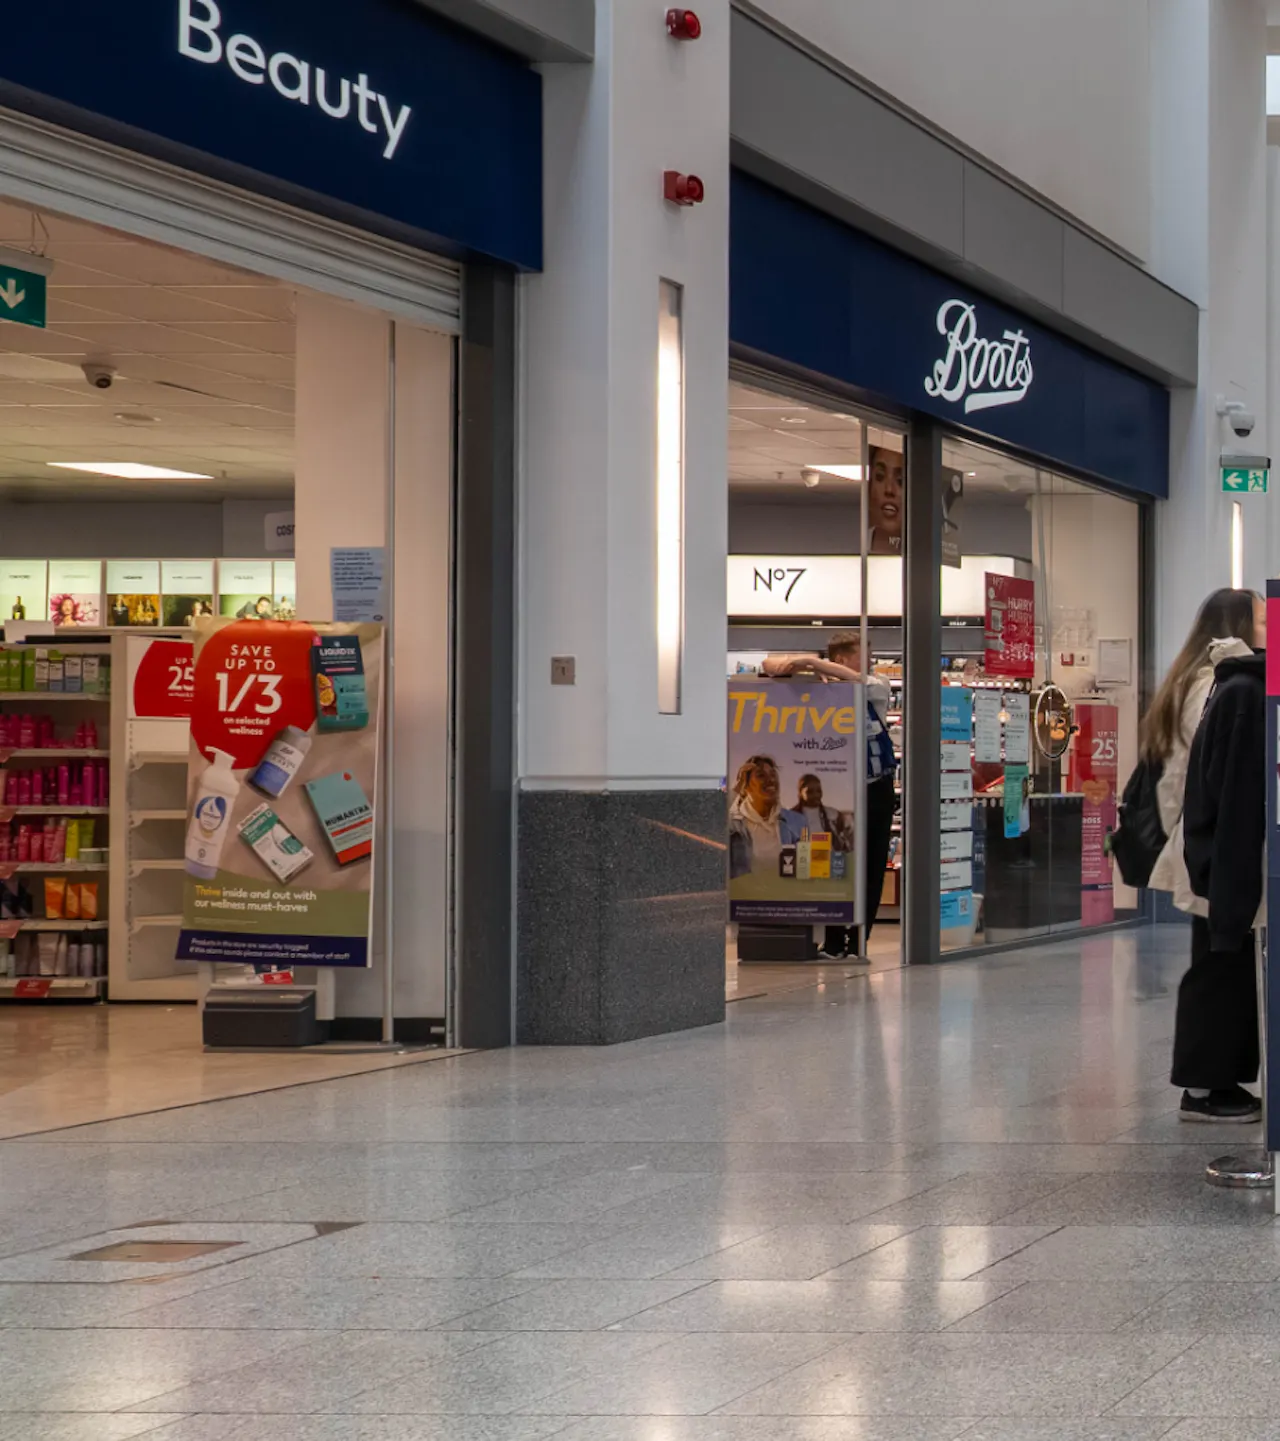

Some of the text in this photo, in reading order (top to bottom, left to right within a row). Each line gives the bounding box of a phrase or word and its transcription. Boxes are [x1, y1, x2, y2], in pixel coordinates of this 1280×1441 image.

[177, 0, 411, 159] Beauty
[925, 299, 1034, 413] Boots
[230, 644, 273, 656] SAVE
[225, 659, 276, 671] UP TO
[215, 672, 283, 714] 1/3
[728, 691, 855, 734] Thrive
[234, 716, 270, 726] selected
[229, 726, 264, 736] wellness
[792, 738, 819, 750] with
[325, 805, 370, 826] HUMANTRA
[195, 885, 317, 901] Thrive inside and out with
[194, 899, 308, 913] our wellness must-haves
